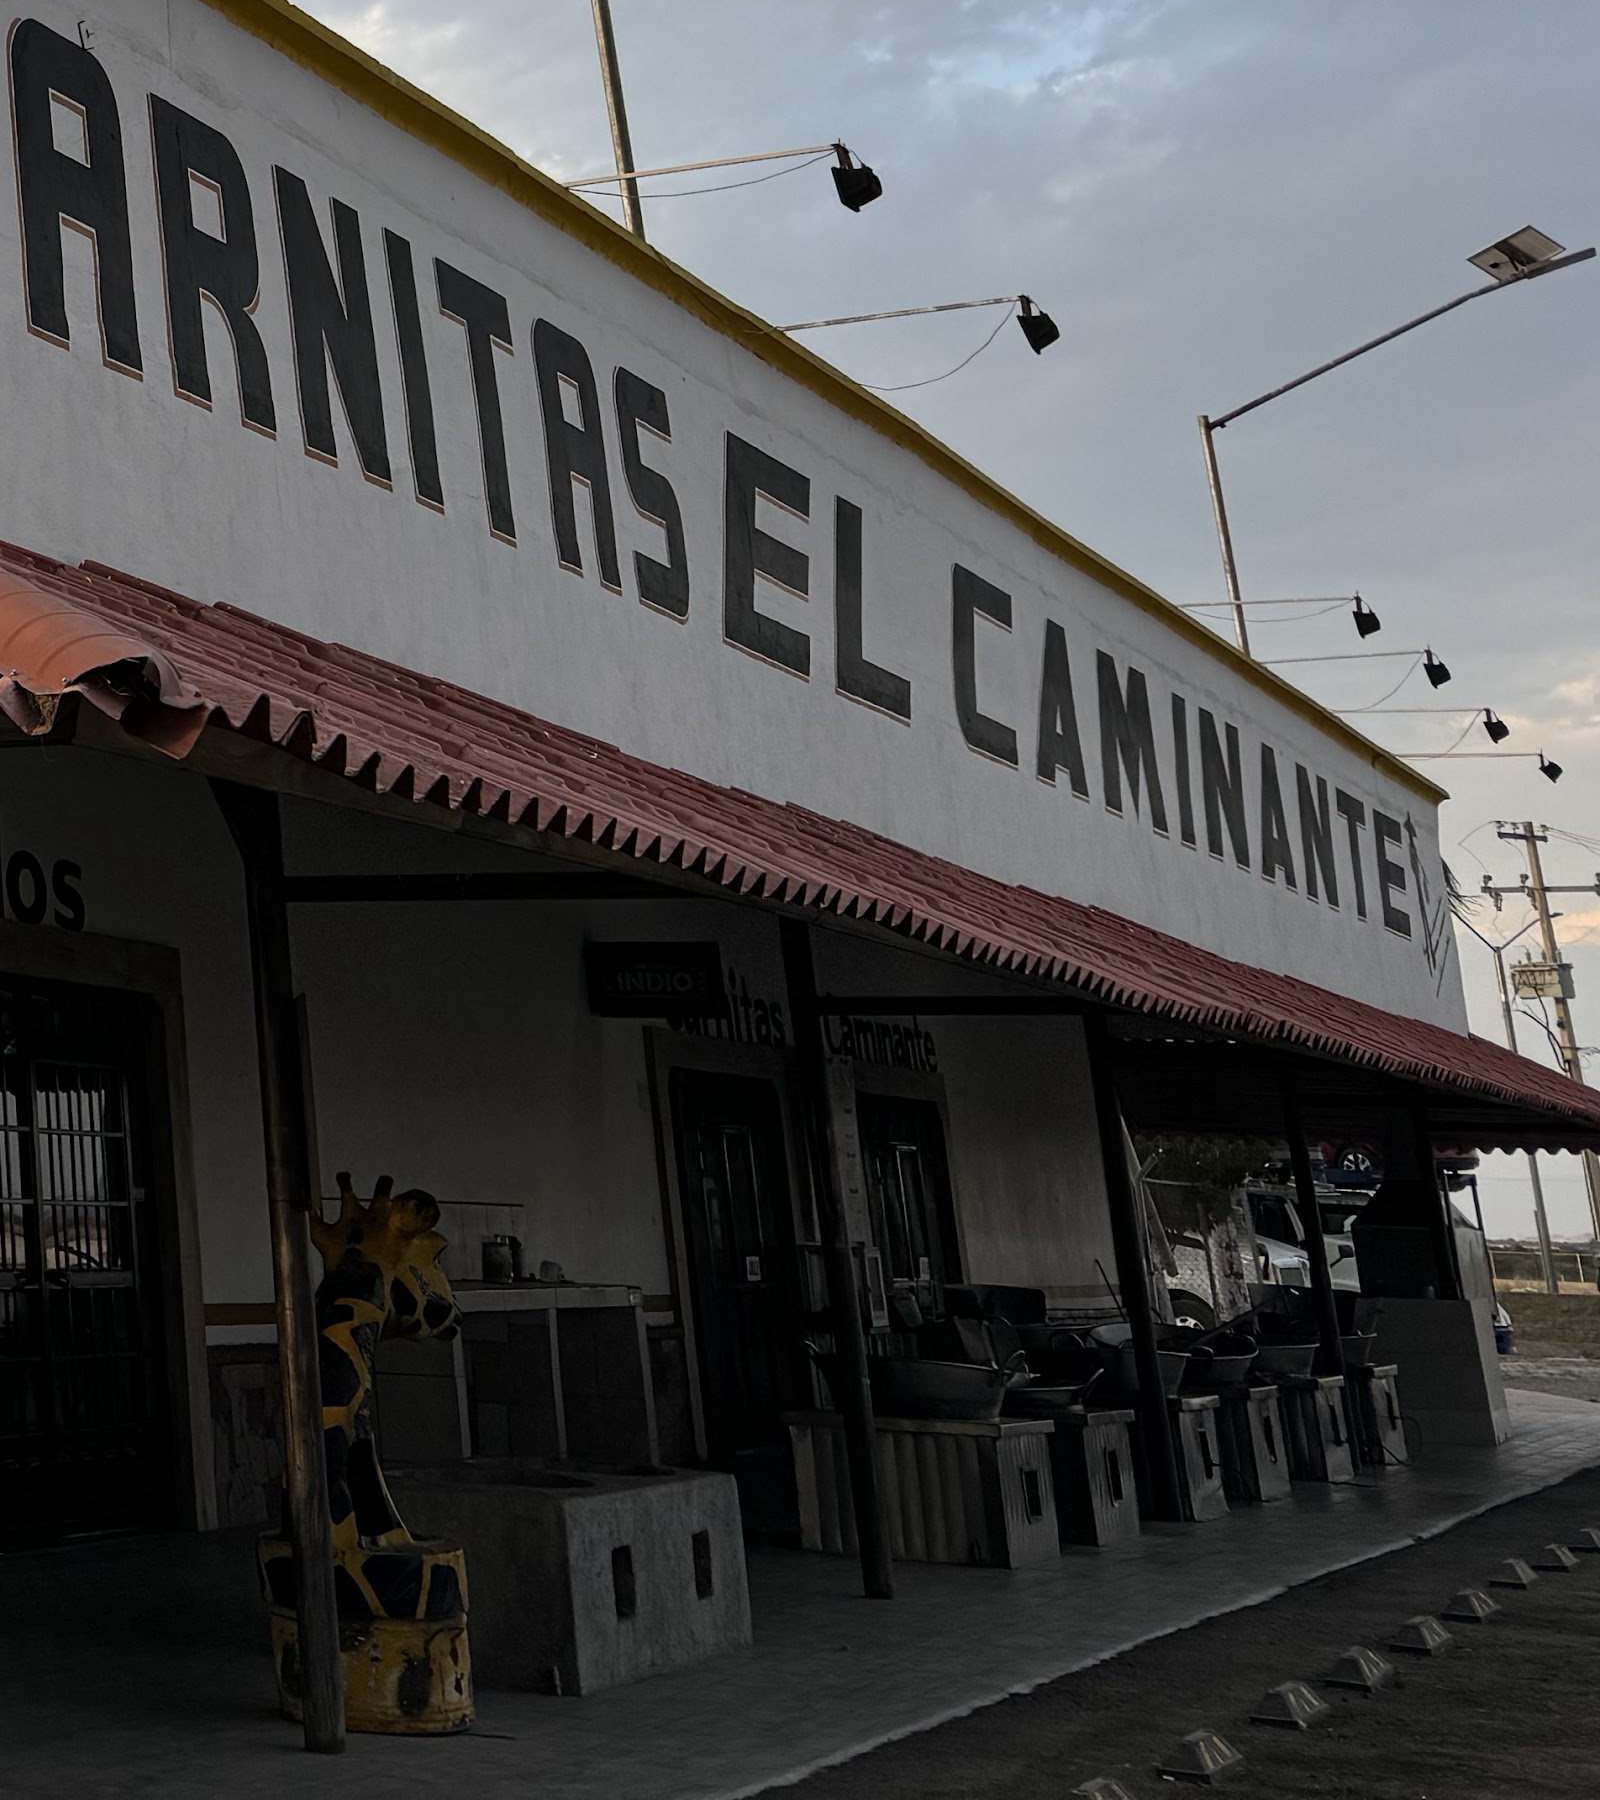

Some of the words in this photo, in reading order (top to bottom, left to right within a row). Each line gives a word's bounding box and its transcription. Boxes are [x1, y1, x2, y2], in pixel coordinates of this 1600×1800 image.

[723, 429, 914, 725] EL
[951, 562, 1412, 942] CAMINANTE
[667, 966, 786, 1049] itas
